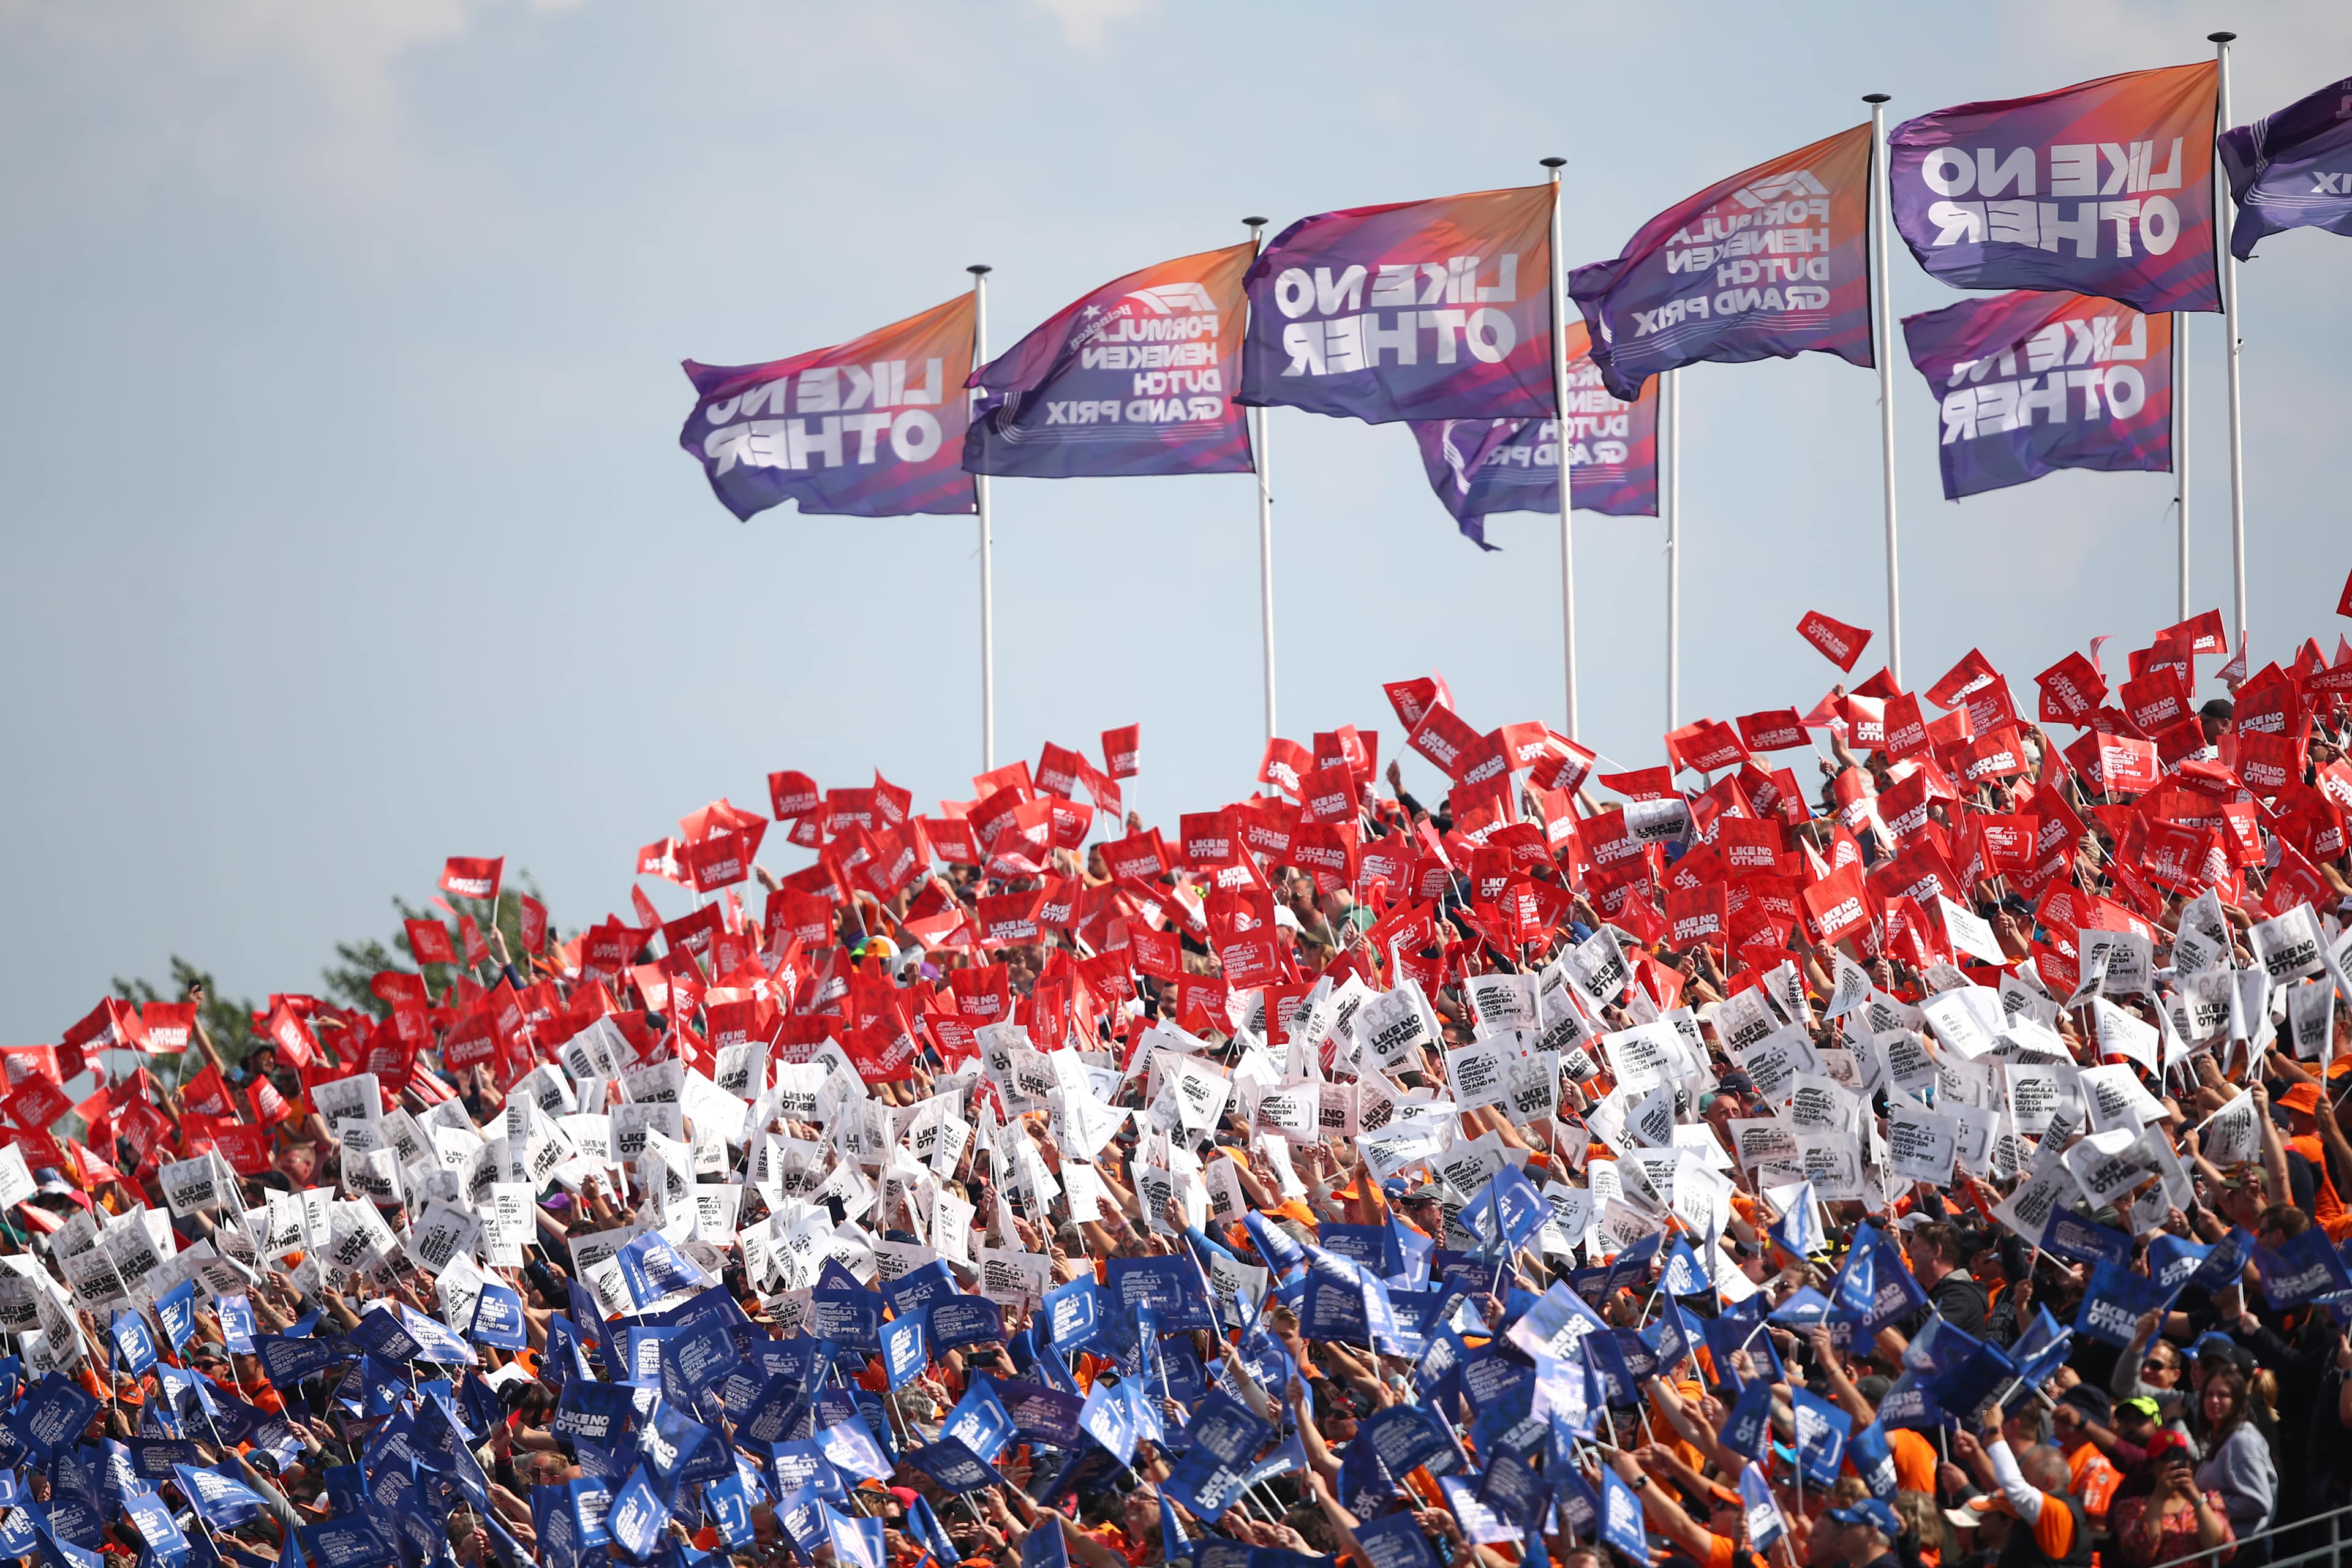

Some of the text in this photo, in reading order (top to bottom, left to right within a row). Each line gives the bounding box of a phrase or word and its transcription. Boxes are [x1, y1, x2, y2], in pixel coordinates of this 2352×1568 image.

[2054, 672, 2089, 710] LIKE NO
[2135, 696, 2176, 718] LIKE NO
[2139, 704, 2180, 727] OTHER!
[2239, 712, 2285, 731] LIKE NO
[1887, 722, 1921, 744] LIKE NO
[1890, 730, 1926, 752] OTHER!
[1464, 755, 1503, 783] LIKE NO
[1965, 752, 2013, 776] LIKE NO
[1967, 758, 2017, 780] OTHER!
[2246, 761, 2286, 777] LIKE NO
[1637, 823, 1664, 835] LIKE
[1296, 845, 1346, 859] LIKE NO
[1593, 840, 1619, 855] LIKE
[1729, 846, 1773, 856] LIKE NO
[1295, 853, 1344, 870] OTHER!
[1730, 856, 1775, 865] OTHER!
[1818, 896, 1859, 926] LIKE NO
[1823, 906, 1864, 935] OTHER!
[989, 920, 1017, 932] LIKE
[1673, 913, 1718, 932] LIKE NO
[1675, 921, 1719, 941] OTHER!
[2266, 940, 2315, 966] LIKE NO
[2269, 950, 2319, 976] OTHER!
[982, 993, 999, 1004] NO
[1477, 993, 1512, 1001] FORMULA
[1371, 1014, 1420, 1047] LIKE NO
[1376, 1023, 1425, 1055] OTHER!
[734, 1069, 748, 1079] NO
[1457, 1060, 1493, 1074] FORMULA
[1748, 1055, 1781, 1076] FORMULA
[1460, 1072, 1485, 1086] DUTCH
[1461, 1080, 1487, 1091] GRAND
[1754, 1070, 1777, 1085] DUTCH
[783, 1090, 815, 1101] LIKE NO
[782, 1102, 816, 1112] OTHER!
[349, 1171, 391, 1188] LIKE NO
[349, 1177, 392, 1196] OTHER!
[172, 1181, 212, 1199] LIKE NO
[423, 1229, 442, 1260] FORMULA
[428, 1231, 447, 1262] HEINEKEN
[432, 1242, 447, 1265] DUTCH
[437, 1229, 461, 1267] GRAND PRIX
[984, 1265, 1019, 1277] FORMULA
[984, 1270, 1020, 1281] HEINEKEN
[78, 1273, 117, 1292] LIKE NO
[985, 1280, 1011, 1289] GRAND
[557, 1408, 610, 1427] LIKE NO
[556, 1419, 608, 1438] OTHER!
